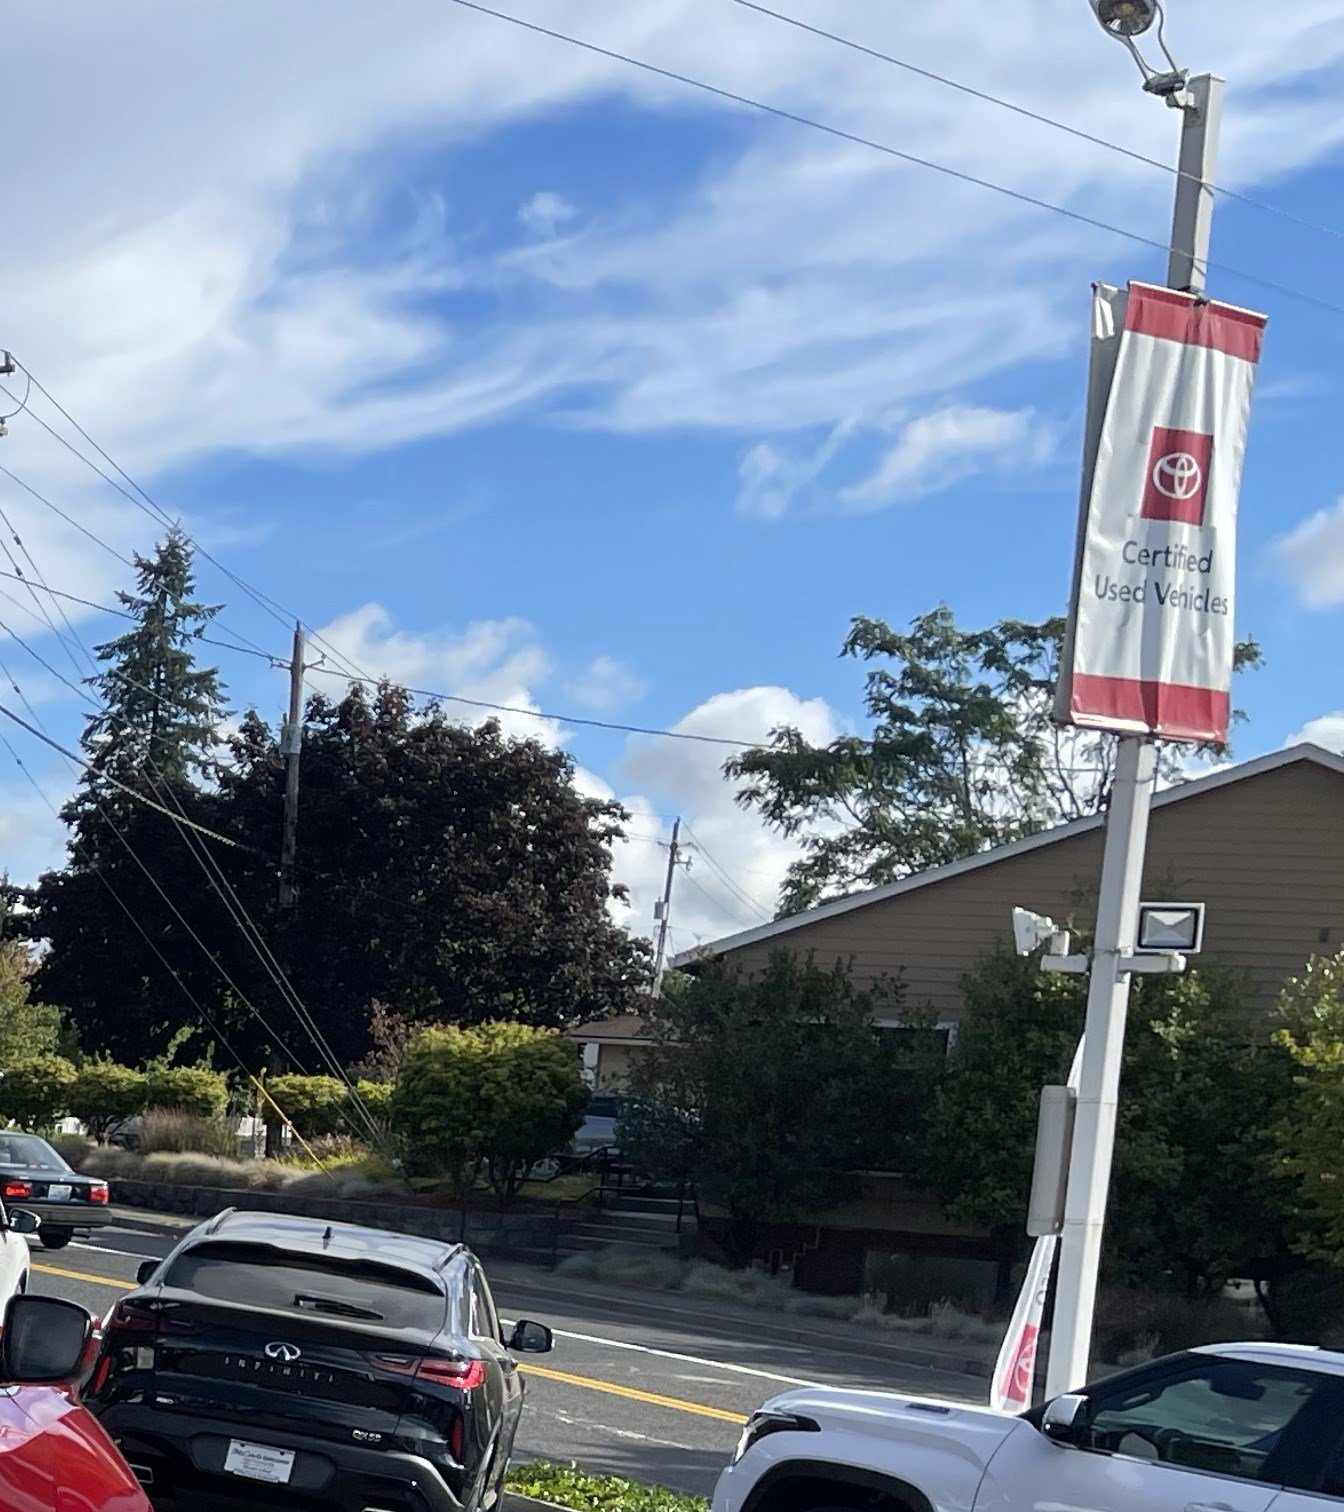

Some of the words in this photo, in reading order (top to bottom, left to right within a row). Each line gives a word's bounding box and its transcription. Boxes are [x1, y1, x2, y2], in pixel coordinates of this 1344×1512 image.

[1122, 540, 1213, 574] Certified
[1094, 574, 1148, 603] Used
[1153, 581, 1228, 615] Vehicles
